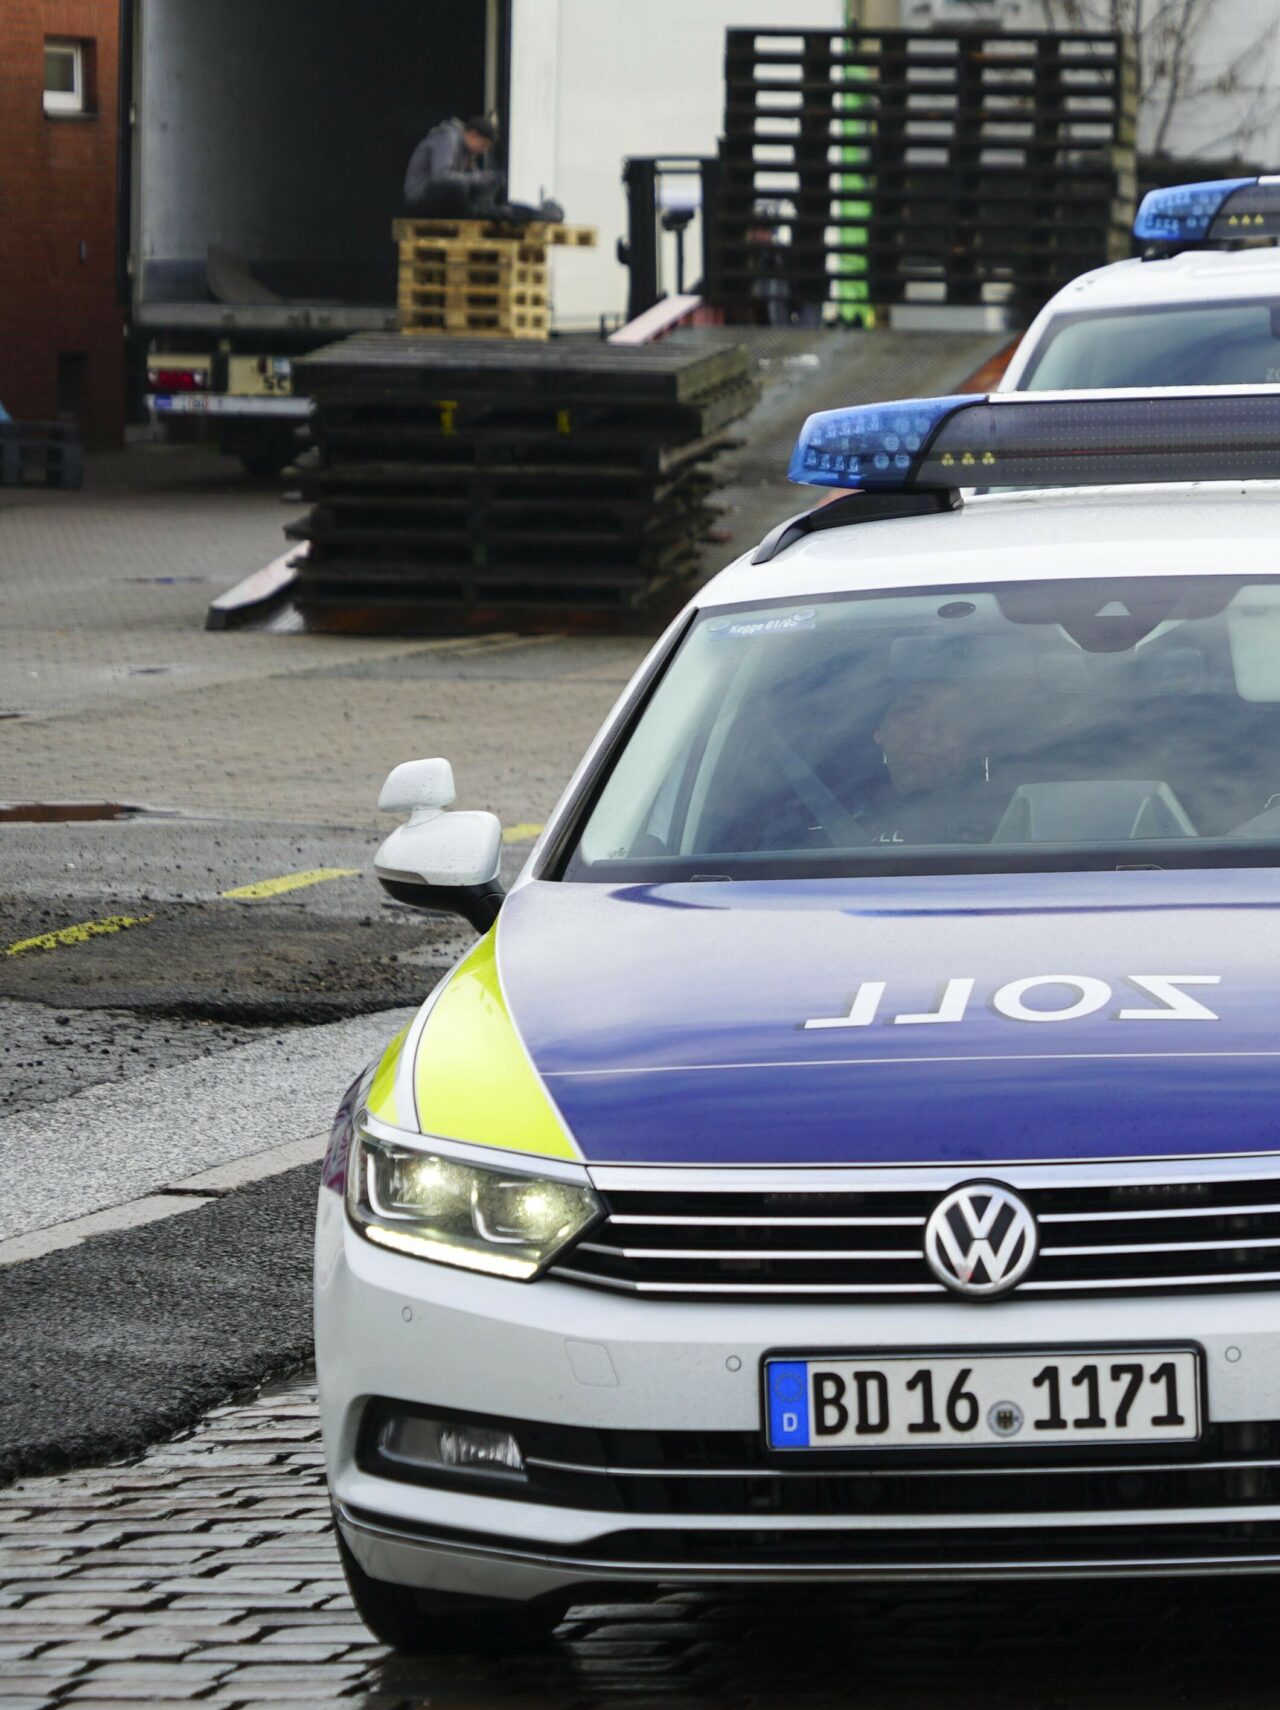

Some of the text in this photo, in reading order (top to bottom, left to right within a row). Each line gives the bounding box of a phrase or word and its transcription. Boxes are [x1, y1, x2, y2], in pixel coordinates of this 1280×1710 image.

[729, 623, 764, 635] Kogge
[928, 1186, 1033, 1293] VW
[782, 1362, 1186, 1436] D BD 16 1171
